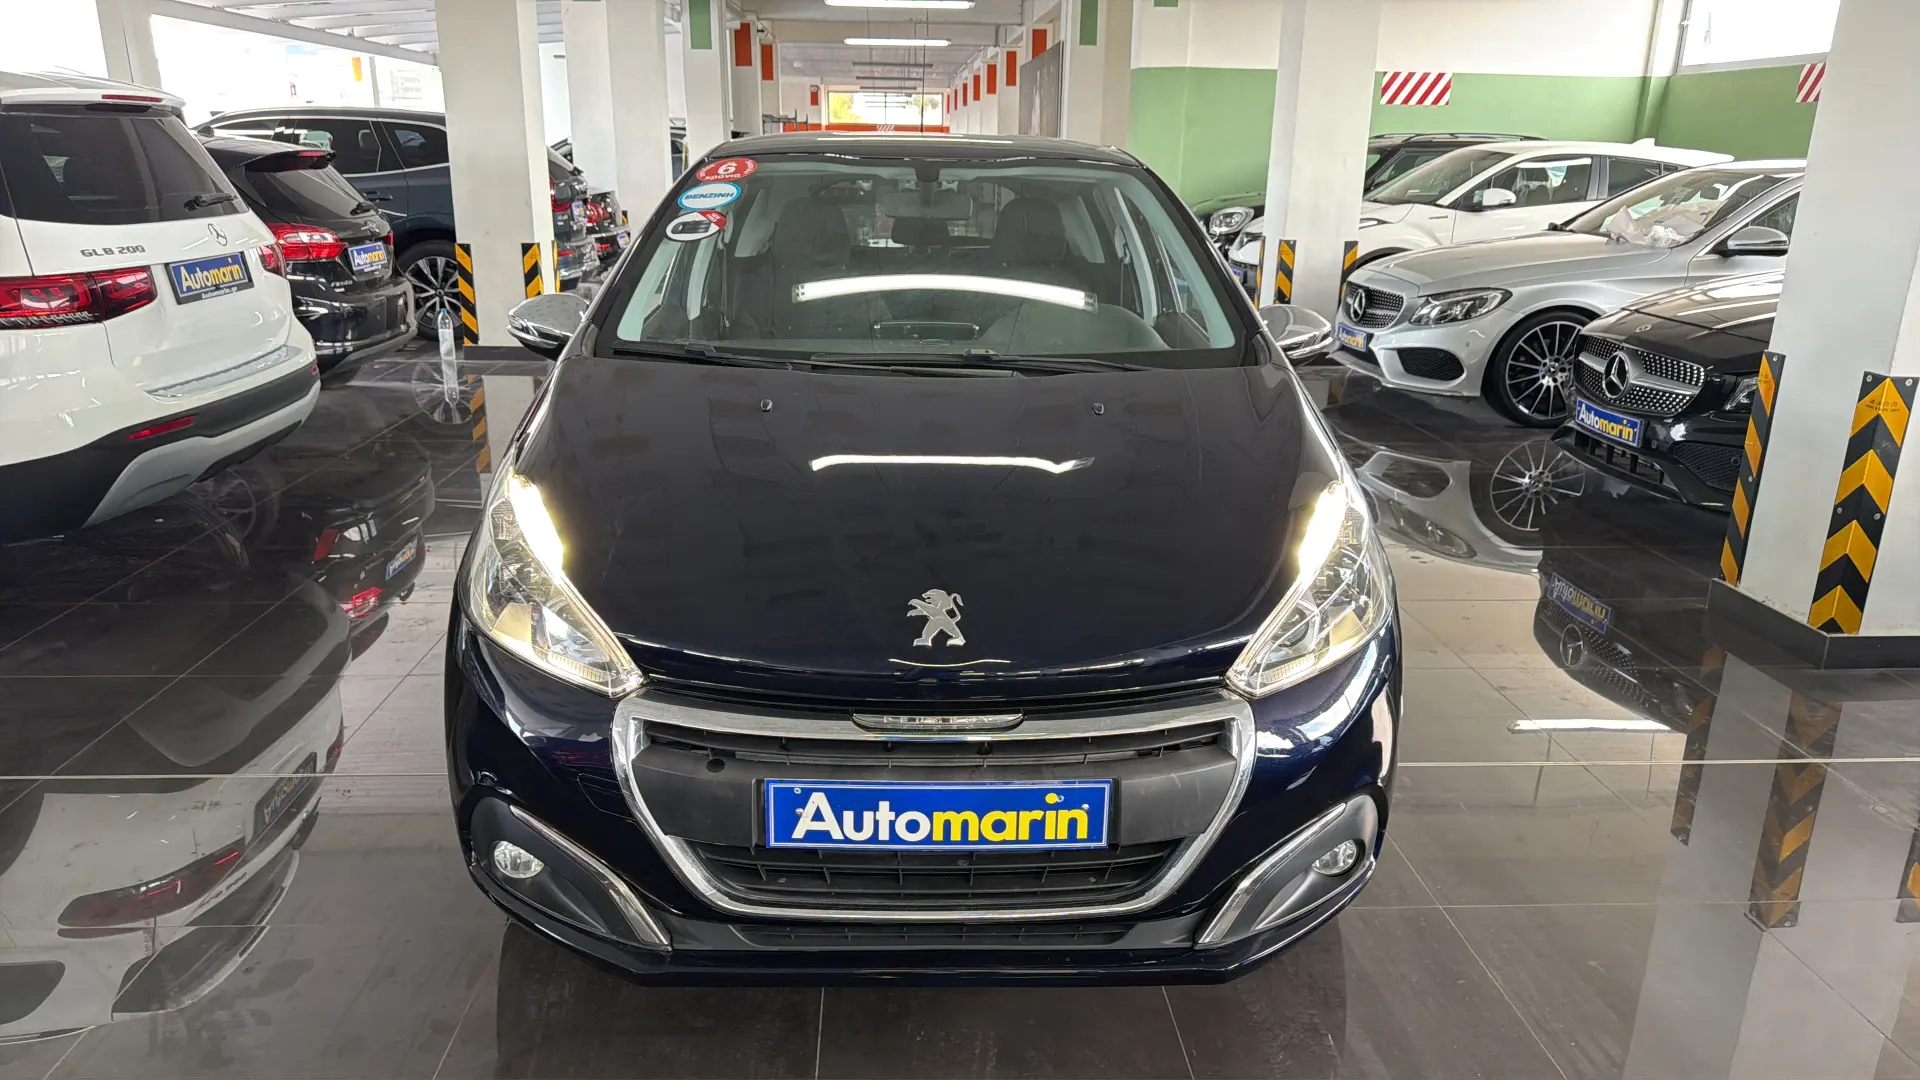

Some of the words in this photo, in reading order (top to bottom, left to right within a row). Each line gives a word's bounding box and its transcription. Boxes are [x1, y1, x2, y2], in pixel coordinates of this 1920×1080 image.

[717, 162, 737, 174] 6
[80, 247, 115, 257] GLB
[118, 244, 146, 255] 200
[180, 257, 243, 292] Automarin
[1578, 402, 1634, 442] Automarin
[791, 791, 1089, 842] Automarin
